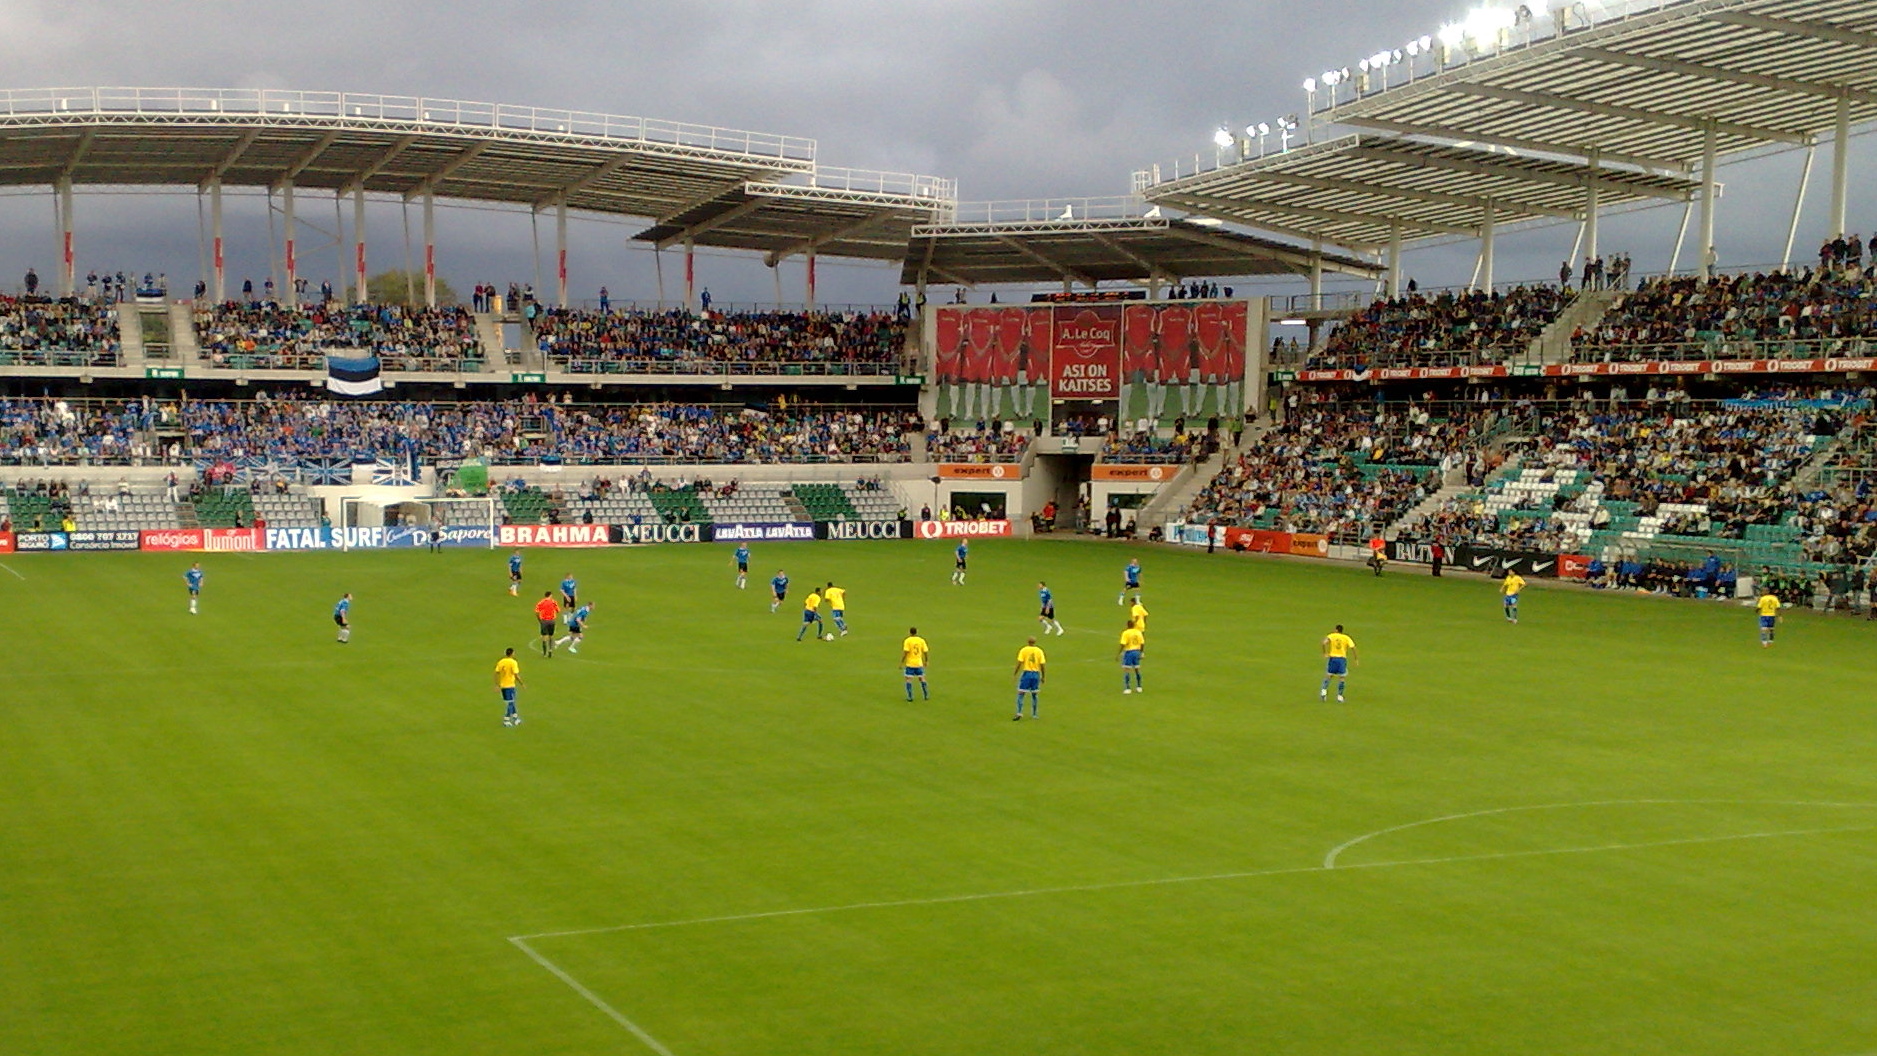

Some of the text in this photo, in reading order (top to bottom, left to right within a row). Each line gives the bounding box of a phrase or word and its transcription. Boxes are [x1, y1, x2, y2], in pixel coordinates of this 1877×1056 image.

[1076, 329, 1088, 339] Le
[1090, 328, 1110, 341] Coq
[1063, 364, 1107, 377] ASI ON
[1059, 379, 1112, 392] KAITSES
[954, 467, 991, 475] expert
[500, 526, 609, 543] BRAHMA
[621, 524, 701, 543] MEUCCI
[827, 521, 901, 540] MEUCCI
[945, 520, 1008, 535] TRIOBET
[145, 531, 199, 547] relógios
[204, 529, 256, 550] Dumont
[266, 528, 326, 549] FATAL
[331, 527, 382, 547] SURF
